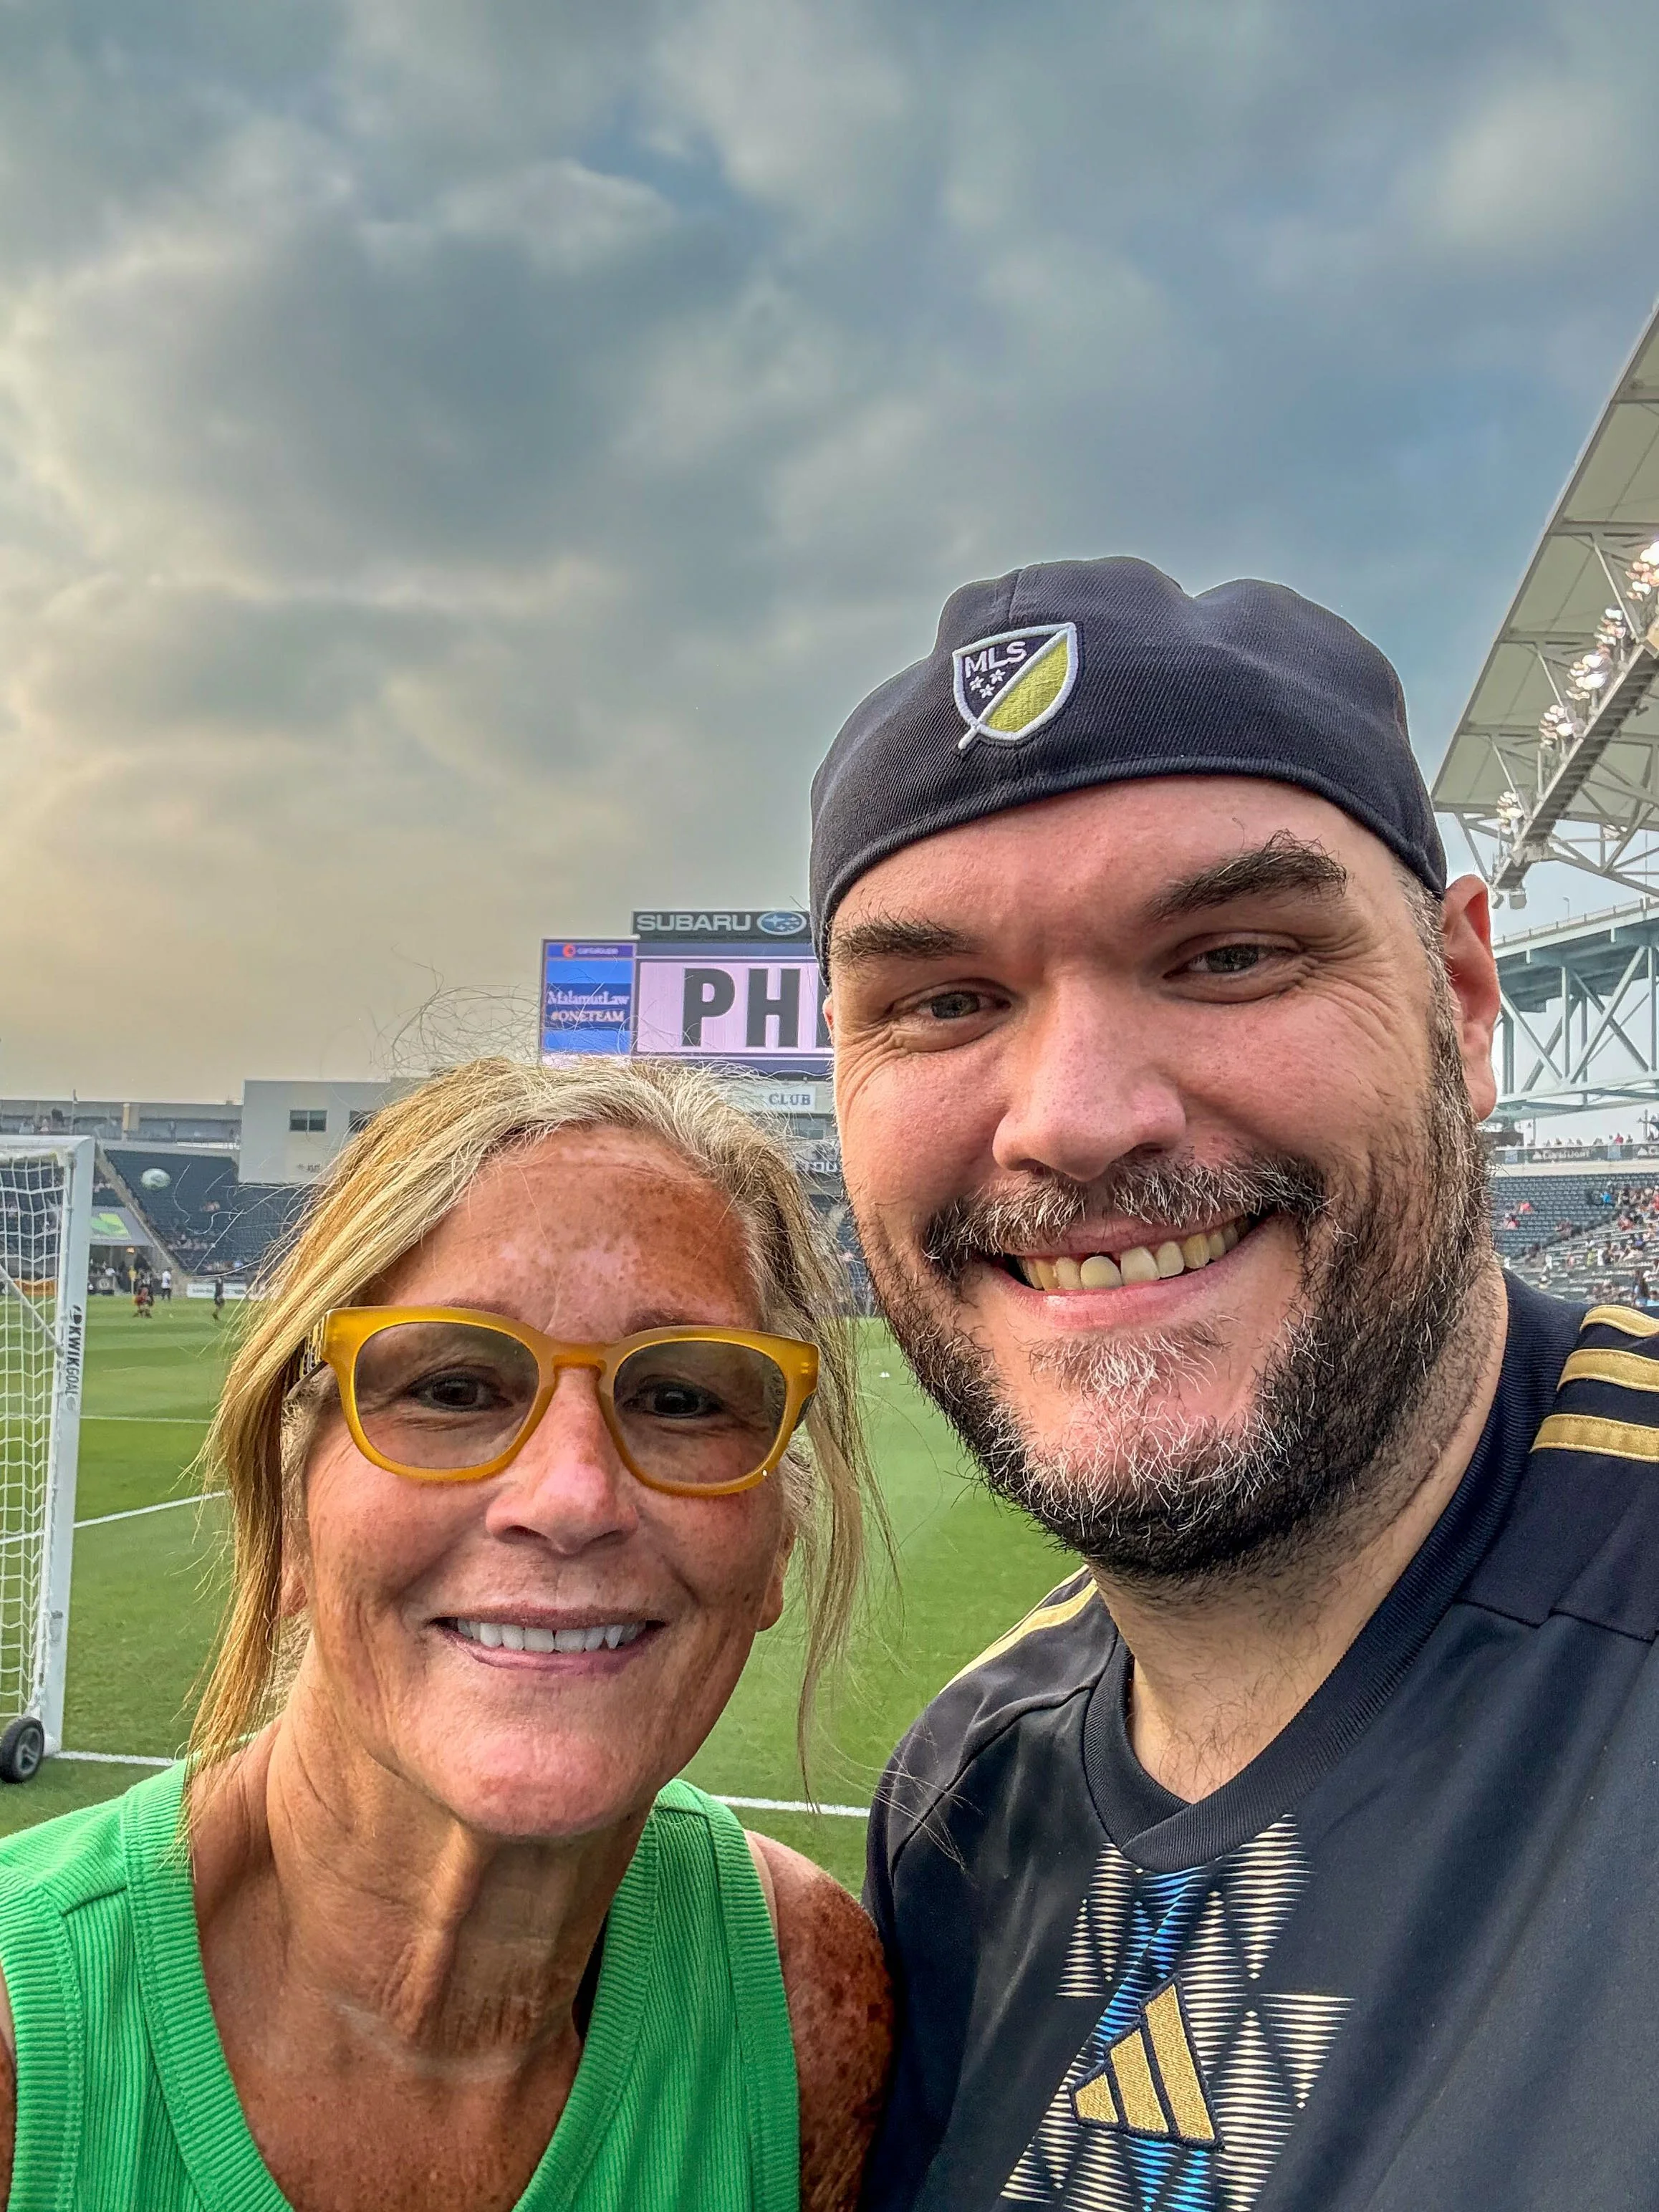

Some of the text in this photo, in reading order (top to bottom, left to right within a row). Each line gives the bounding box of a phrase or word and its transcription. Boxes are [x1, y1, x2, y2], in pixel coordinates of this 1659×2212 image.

[965, 641, 1027, 678] MLS
[637, 914, 751, 931] SUBARU
[769, 1093, 811, 1105] CLUB
